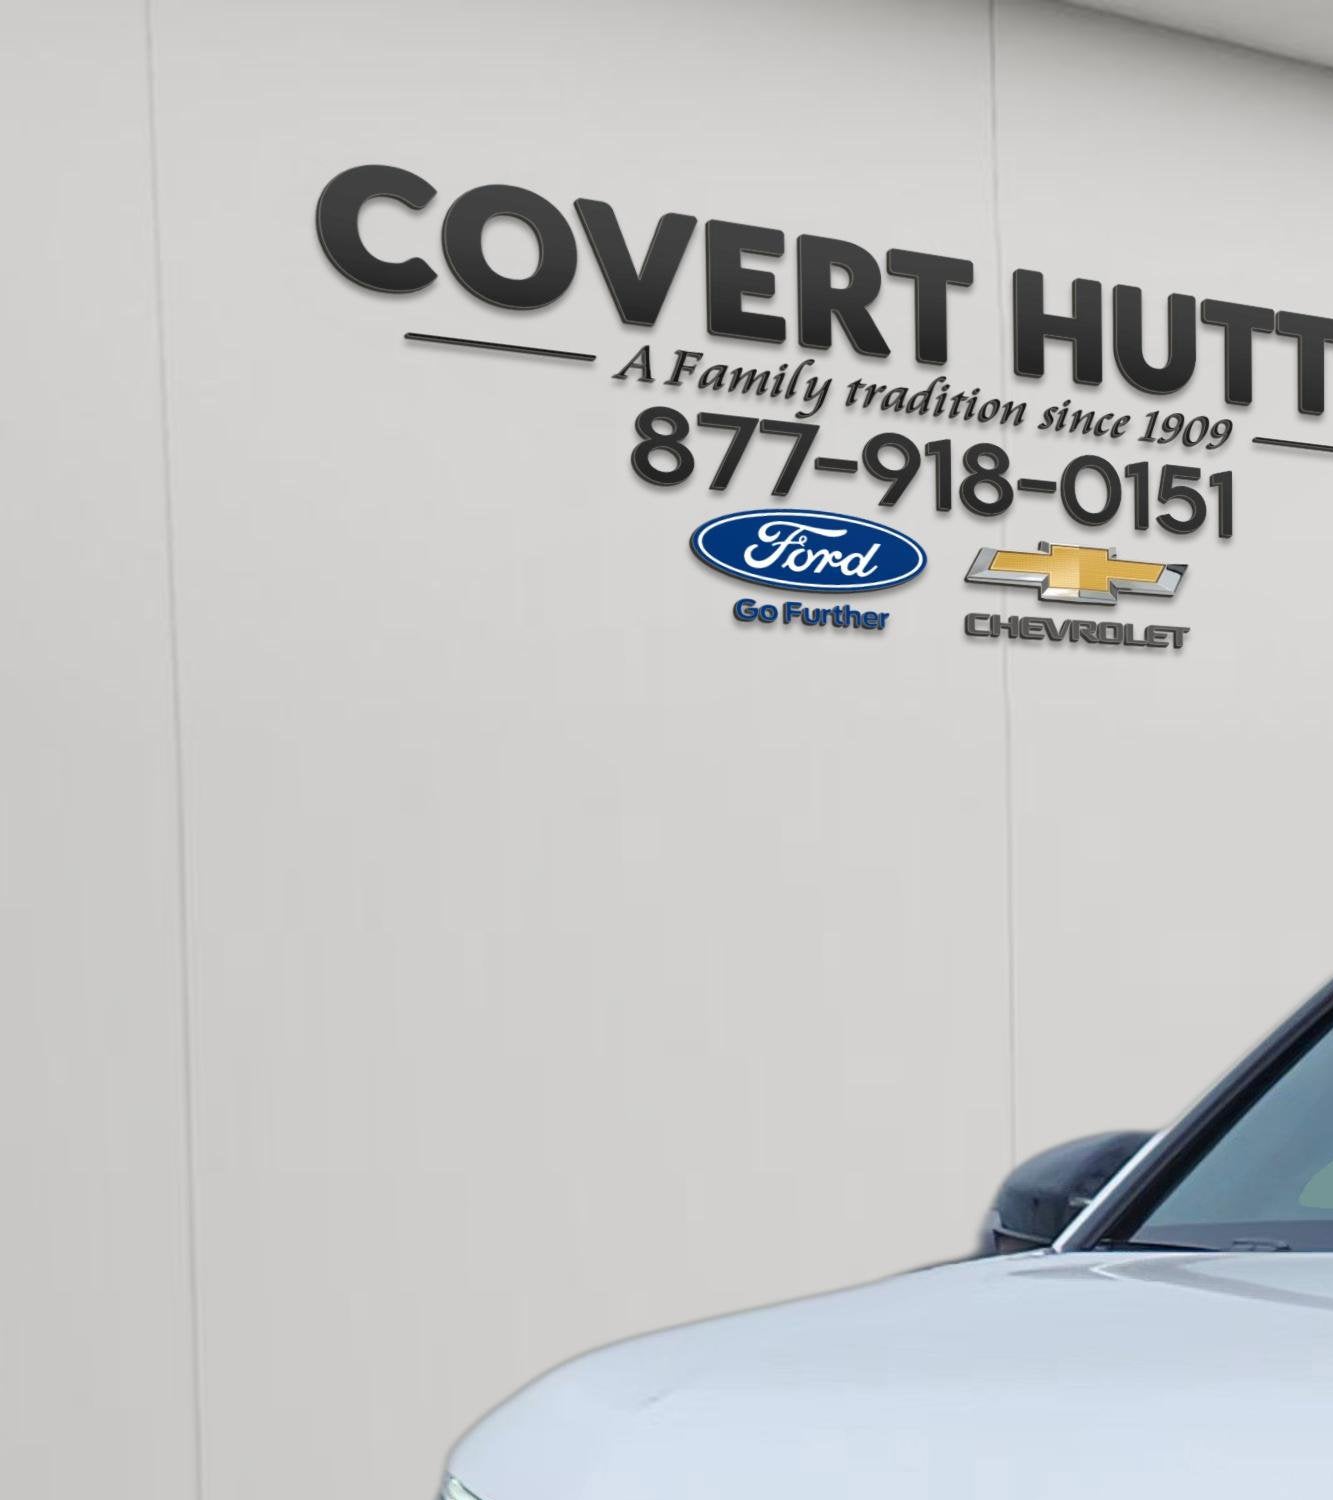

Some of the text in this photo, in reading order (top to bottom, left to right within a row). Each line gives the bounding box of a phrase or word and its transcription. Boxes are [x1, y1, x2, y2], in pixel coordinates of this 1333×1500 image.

[315, 164, 974, 367] COVERT
[611, 344, 1234, 450] A Family tradition since 1909
[630, 406, 1233, 540] 877-918-0151
[743, 520, 882, 578] Ford
[732, 598, 890, 631] Go Further
[964, 613, 1190, 650] CHEVROLET
